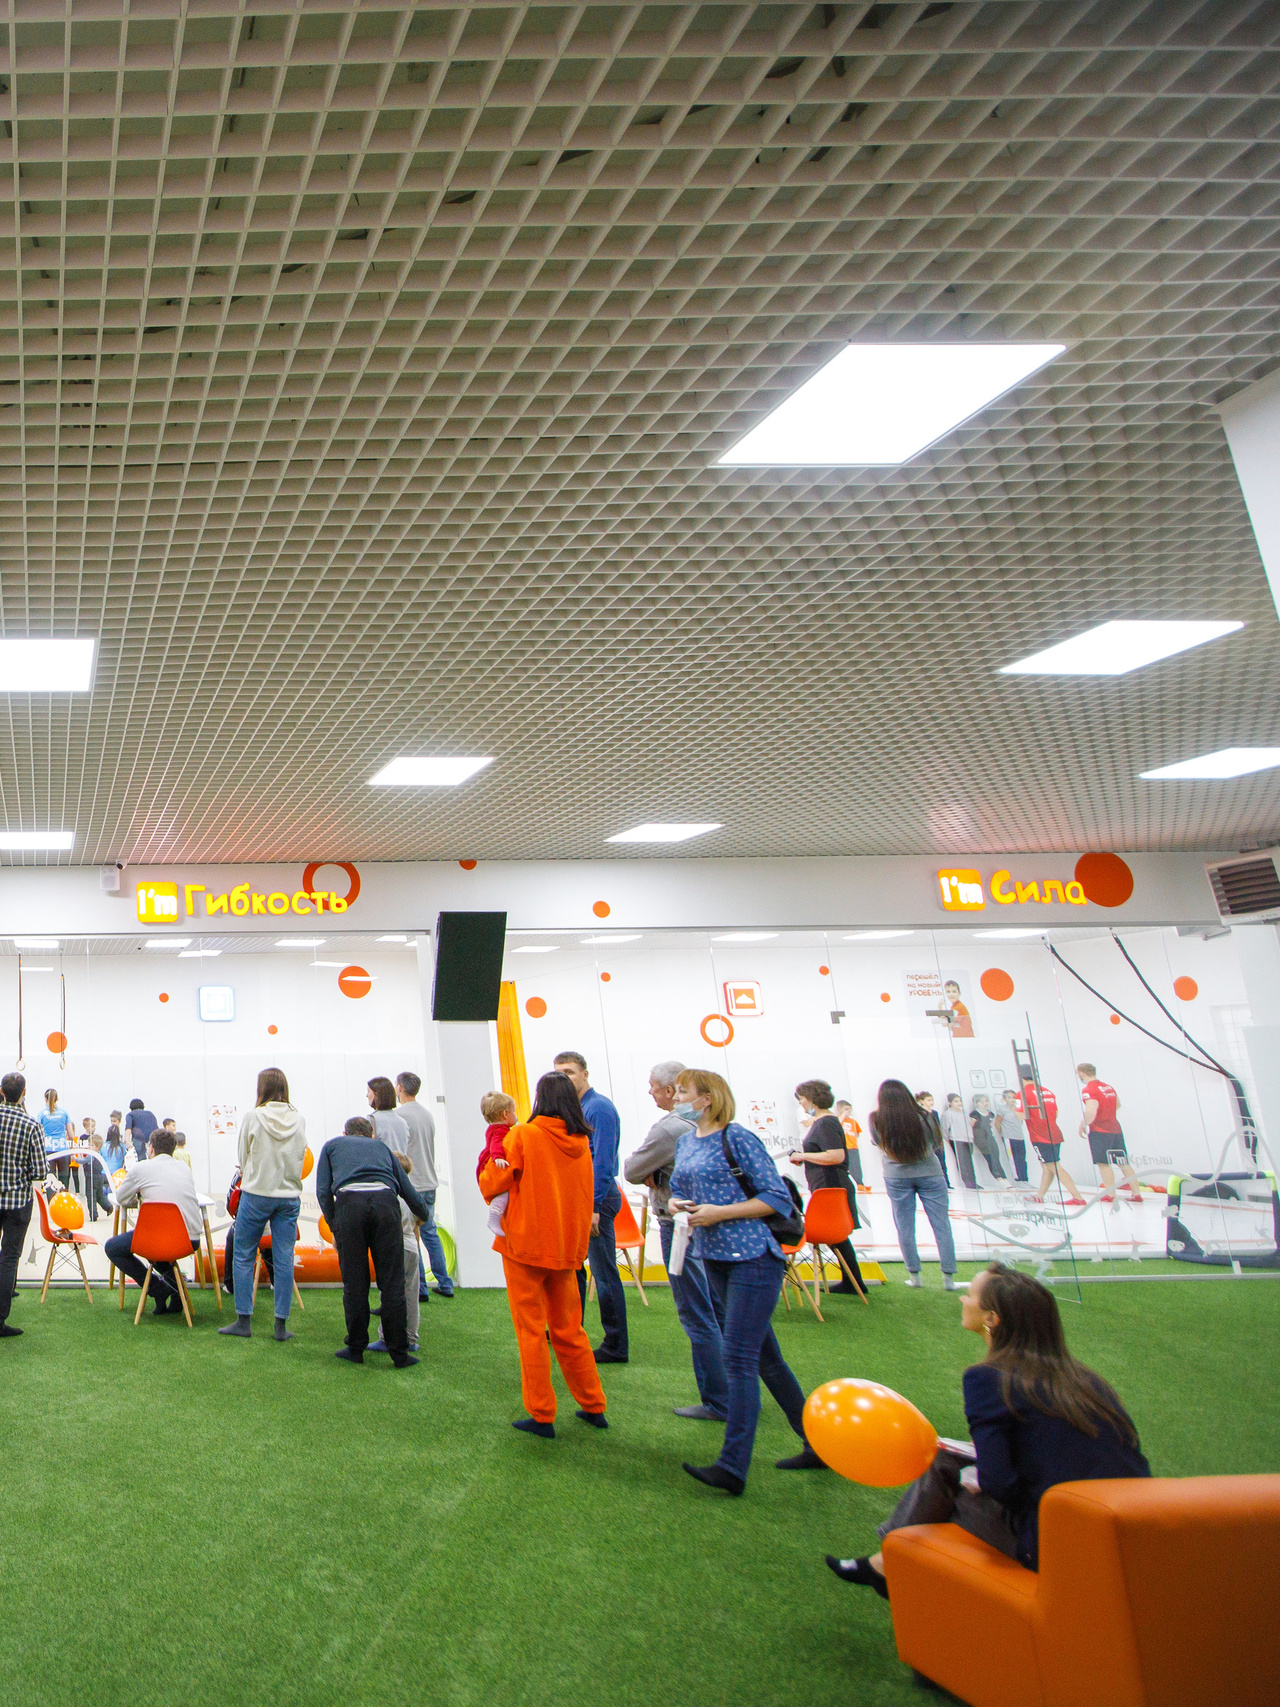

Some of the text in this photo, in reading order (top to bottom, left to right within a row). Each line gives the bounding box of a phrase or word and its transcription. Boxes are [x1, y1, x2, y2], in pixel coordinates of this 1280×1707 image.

[138, 882, 348, 916] I'm Гибкость
[940, 869, 1088, 905] I'm Сила
